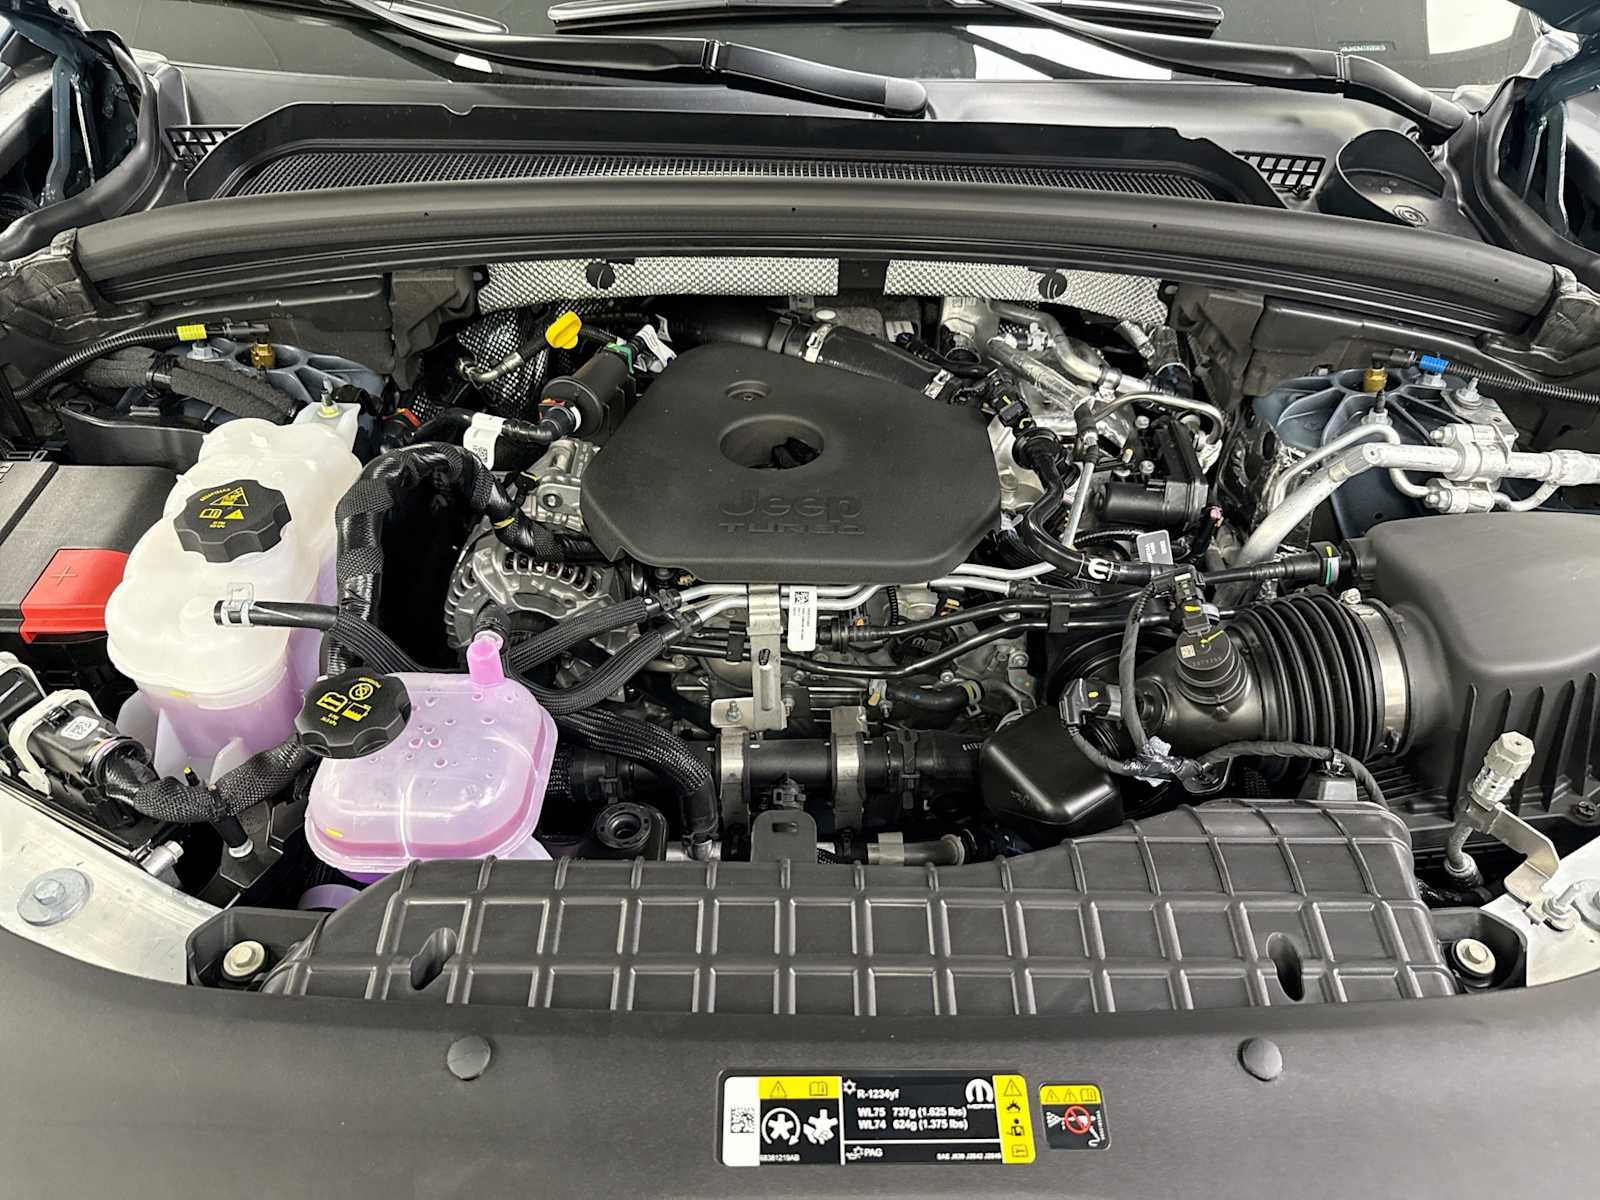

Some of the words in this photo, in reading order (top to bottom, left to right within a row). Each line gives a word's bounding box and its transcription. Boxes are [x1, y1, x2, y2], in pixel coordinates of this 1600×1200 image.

[719, 489, 864, 523] Jeep
[857, 1088, 899, 1100] R-1234yf
[857, 1106, 886, 1117] WL75
[892, 1106, 917, 1118] 737g
[917, 1106, 947, 1118] (1.625
[947, 1106, 967, 1118] lbs)
[858, 1119, 887, 1129] WL74
[893, 1119, 917, 1131] 624g
[918, 1119, 948, 1131] (1.375
[949, 1119, 968, 1131] lbs)
[864, 1147, 883, 1157] PAG
